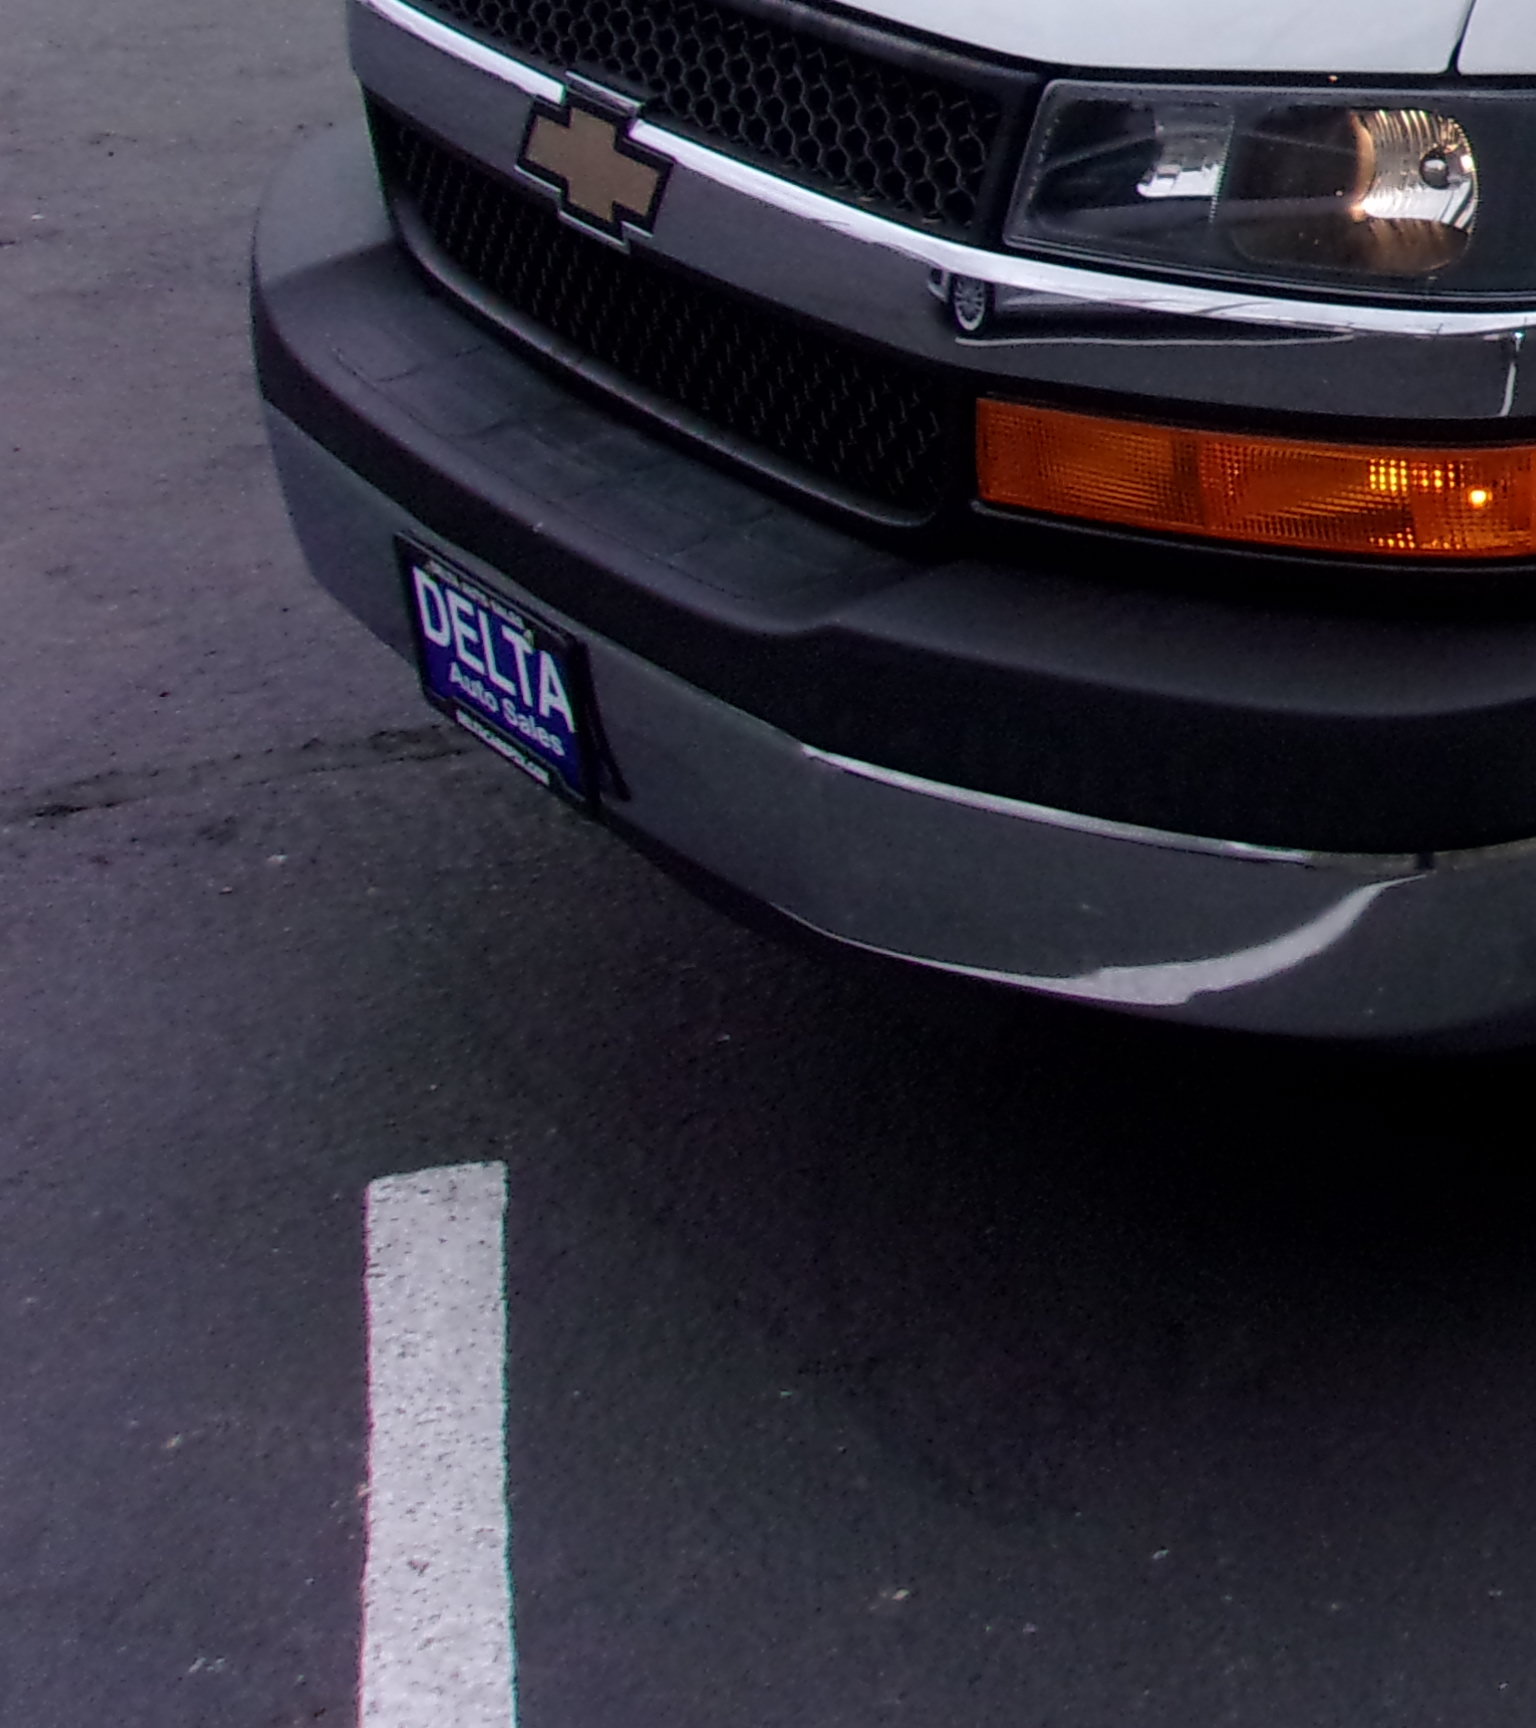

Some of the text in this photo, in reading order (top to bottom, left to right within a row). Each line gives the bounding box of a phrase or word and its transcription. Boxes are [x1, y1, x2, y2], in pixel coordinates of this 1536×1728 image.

[412, 566, 576, 733] DELTA
[449, 662, 499, 712] Auto
[502, 698, 566, 757] Sales
